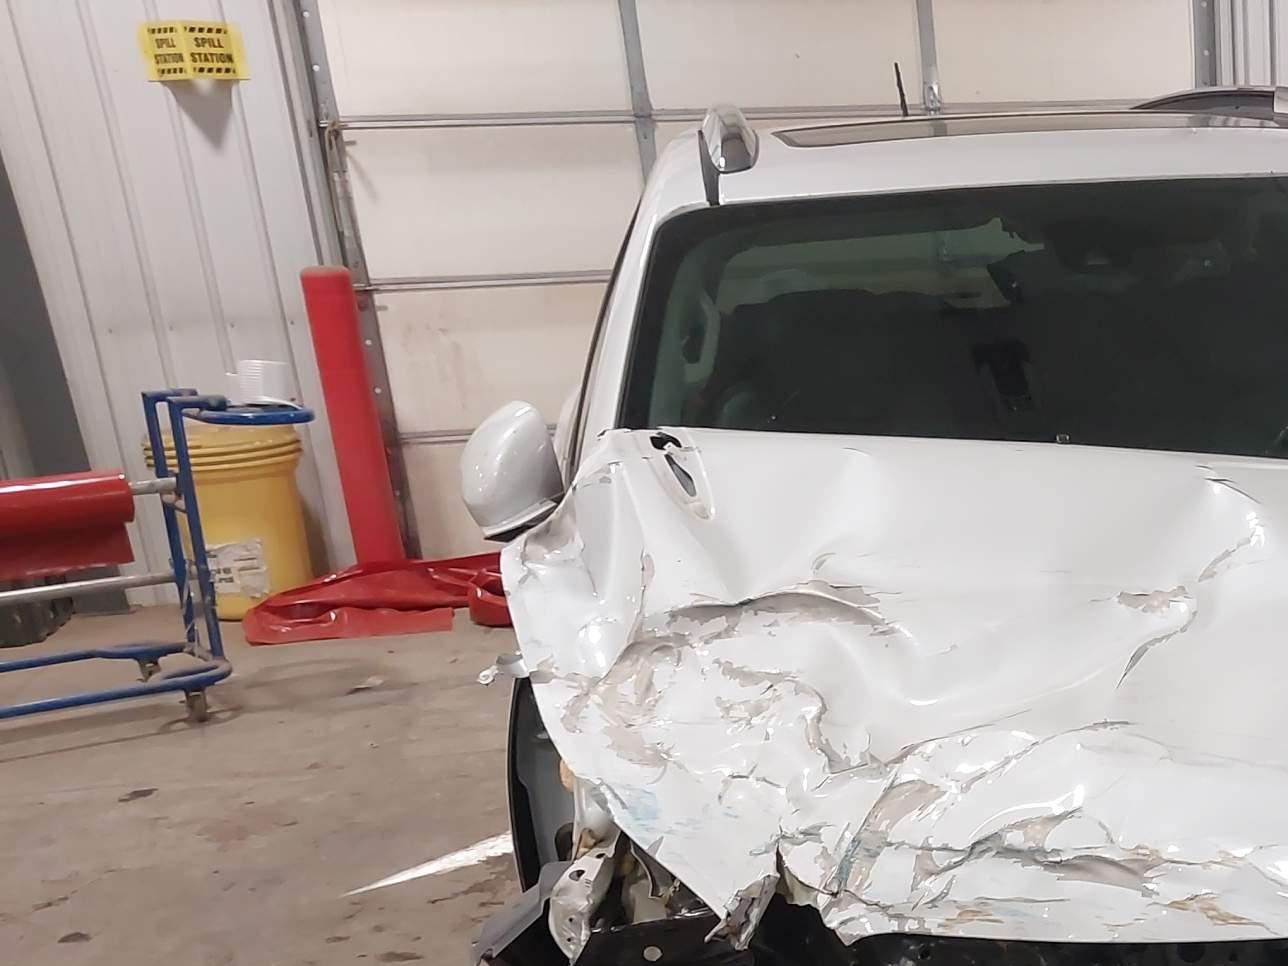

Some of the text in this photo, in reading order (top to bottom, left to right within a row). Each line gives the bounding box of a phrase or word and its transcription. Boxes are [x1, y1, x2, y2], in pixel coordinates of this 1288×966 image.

[155, 38, 176, 49] SPILL
[194, 37, 224, 49] SPILL
[154, 53, 184, 65] STATION
[190, 52, 234, 64] STATION
